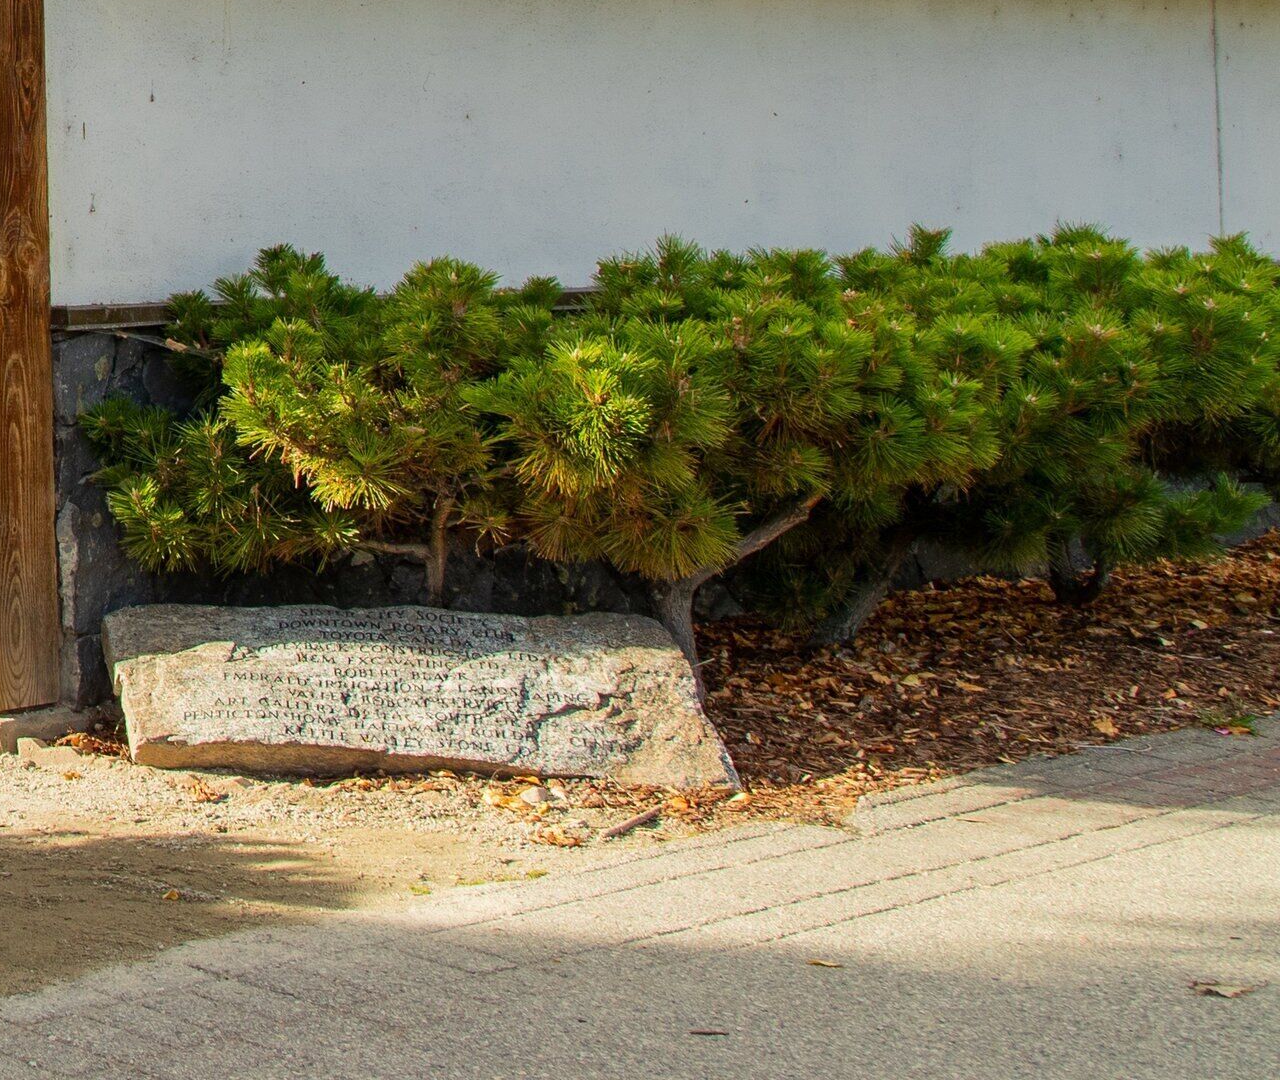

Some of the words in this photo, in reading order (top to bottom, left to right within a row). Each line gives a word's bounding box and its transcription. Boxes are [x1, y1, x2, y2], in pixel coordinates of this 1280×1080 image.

[278, 619, 381, 631] DOWNTOWN
[391, 623, 461, 636] ROTARY
[472, 629, 515, 643] CLUB
[319, 630, 389, 641] TOYOTA
[398, 635, 475, 649] CANADA
[258, 643, 349, 653] GREYBACK
[348, 657, 452, 670] EXCAVATING
[334, 670, 398, 680] ROBERT
[413, 672, 468, 682] BLACK
[224, 672, 308, 687] EMERALD
[319, 680, 425, 693] IRRIGATION
[458, 684, 589, 703] LANDSCAPING
[215, 697, 247, 706] ART
[259, 697, 336, 714] GALLERY
[288, 689, 351, 705] VALLEY
[362, 695, 430, 708] BOBCAT
[184, 710, 279, 721] PENTICTON
[285, 726, 348, 741] KETTLE
[360, 734, 424, 749] VALLEY
[438, 738, 492, 753] STONE
